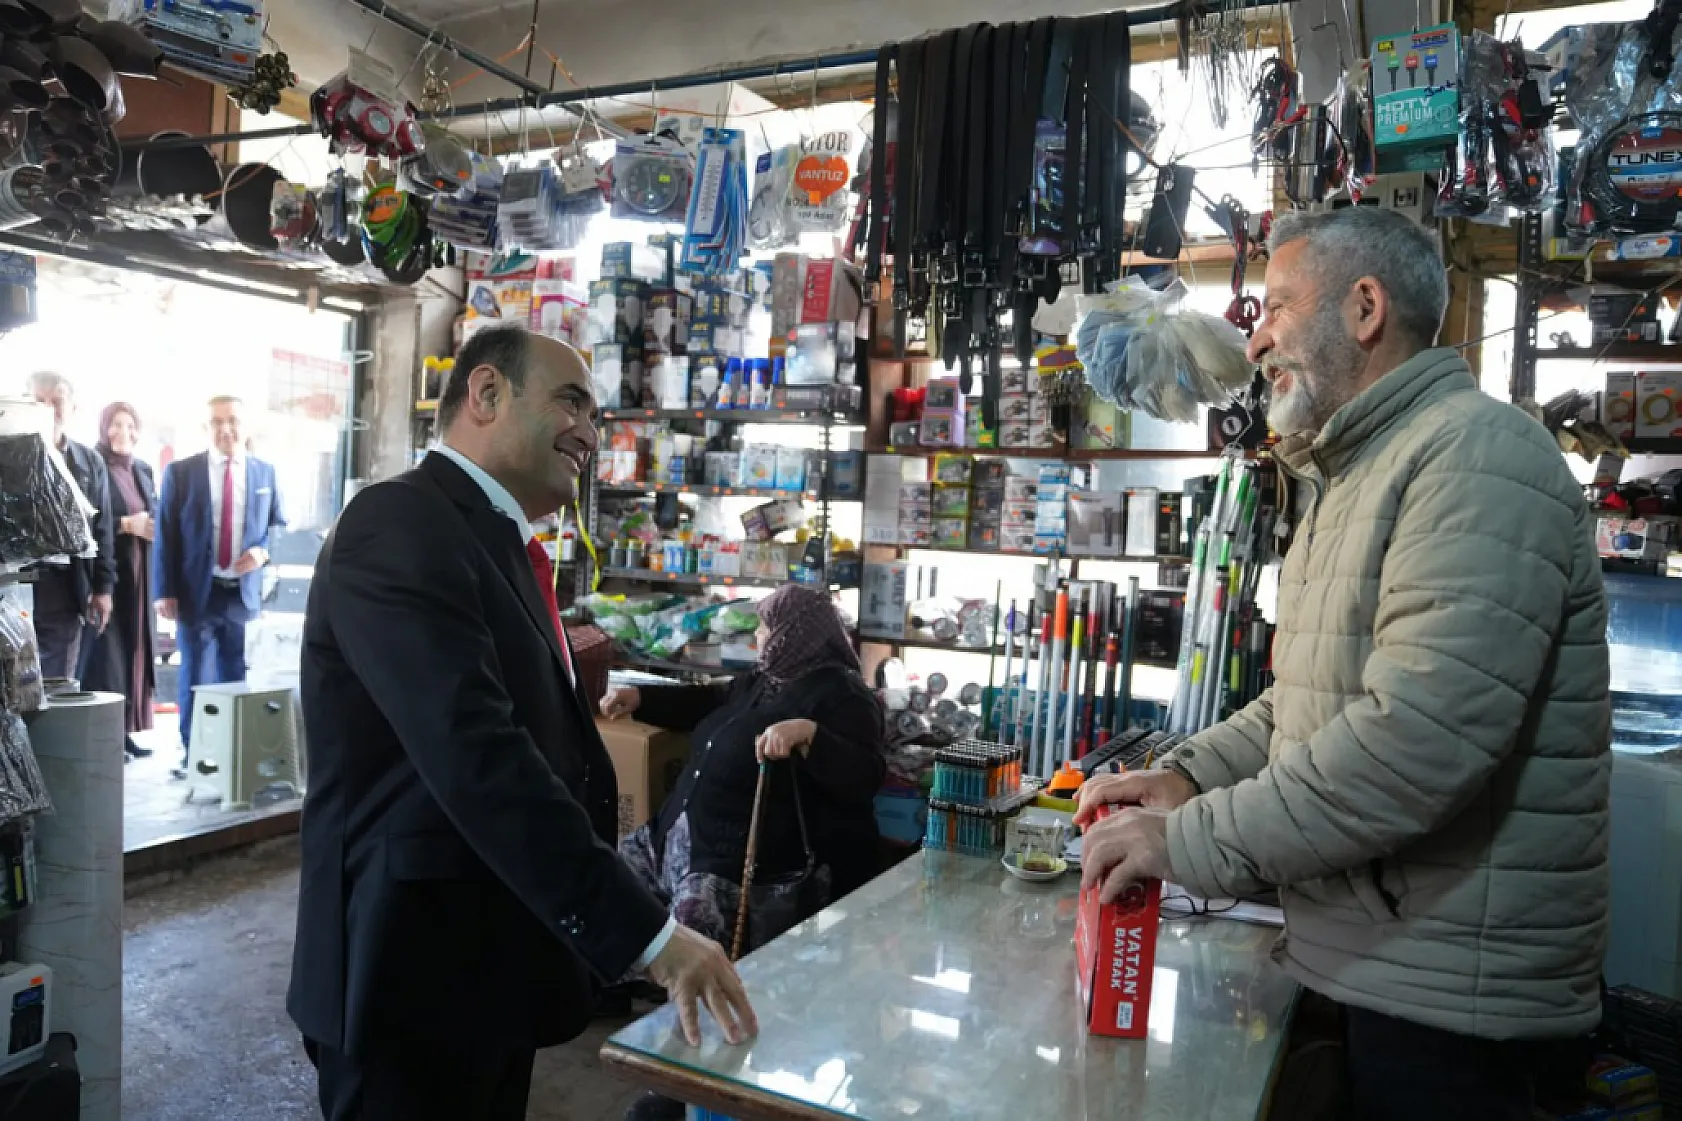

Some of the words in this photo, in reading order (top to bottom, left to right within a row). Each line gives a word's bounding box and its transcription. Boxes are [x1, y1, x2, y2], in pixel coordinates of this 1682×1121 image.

[1378, 106, 1432, 125] PREMIUM
[1110, 926, 1126, 989] BAYRAK
[1122, 926, 1142, 994] VATAN
